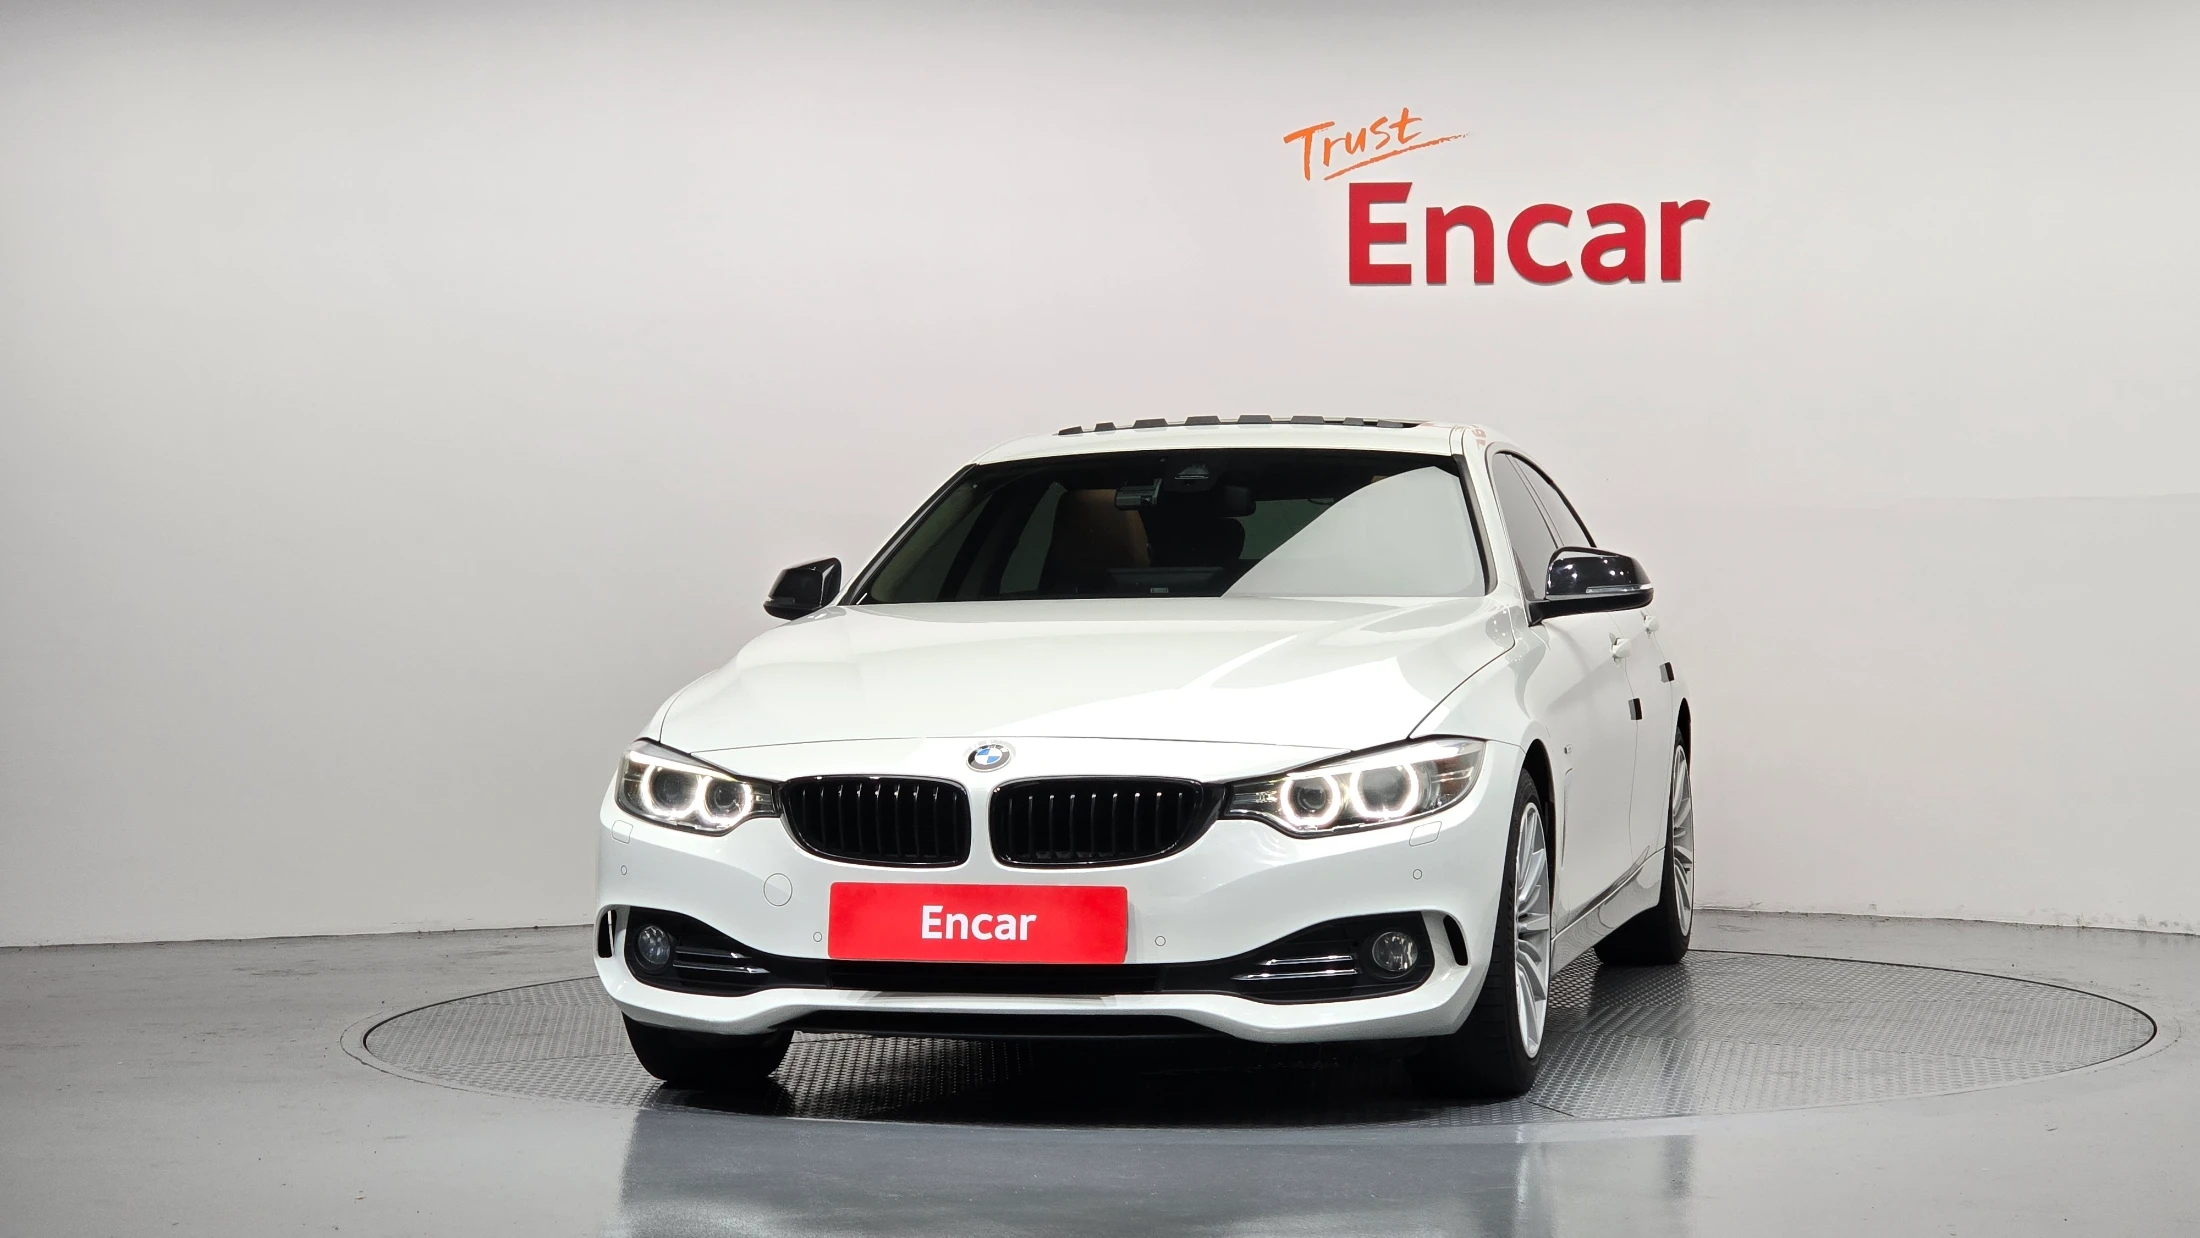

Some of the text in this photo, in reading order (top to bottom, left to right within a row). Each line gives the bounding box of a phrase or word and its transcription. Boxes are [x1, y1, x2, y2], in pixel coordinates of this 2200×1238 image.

[1283, 107, 1423, 181] Trust
[1349, 182, 1710, 285] Encar
[921, 905, 1037, 941] Encar
